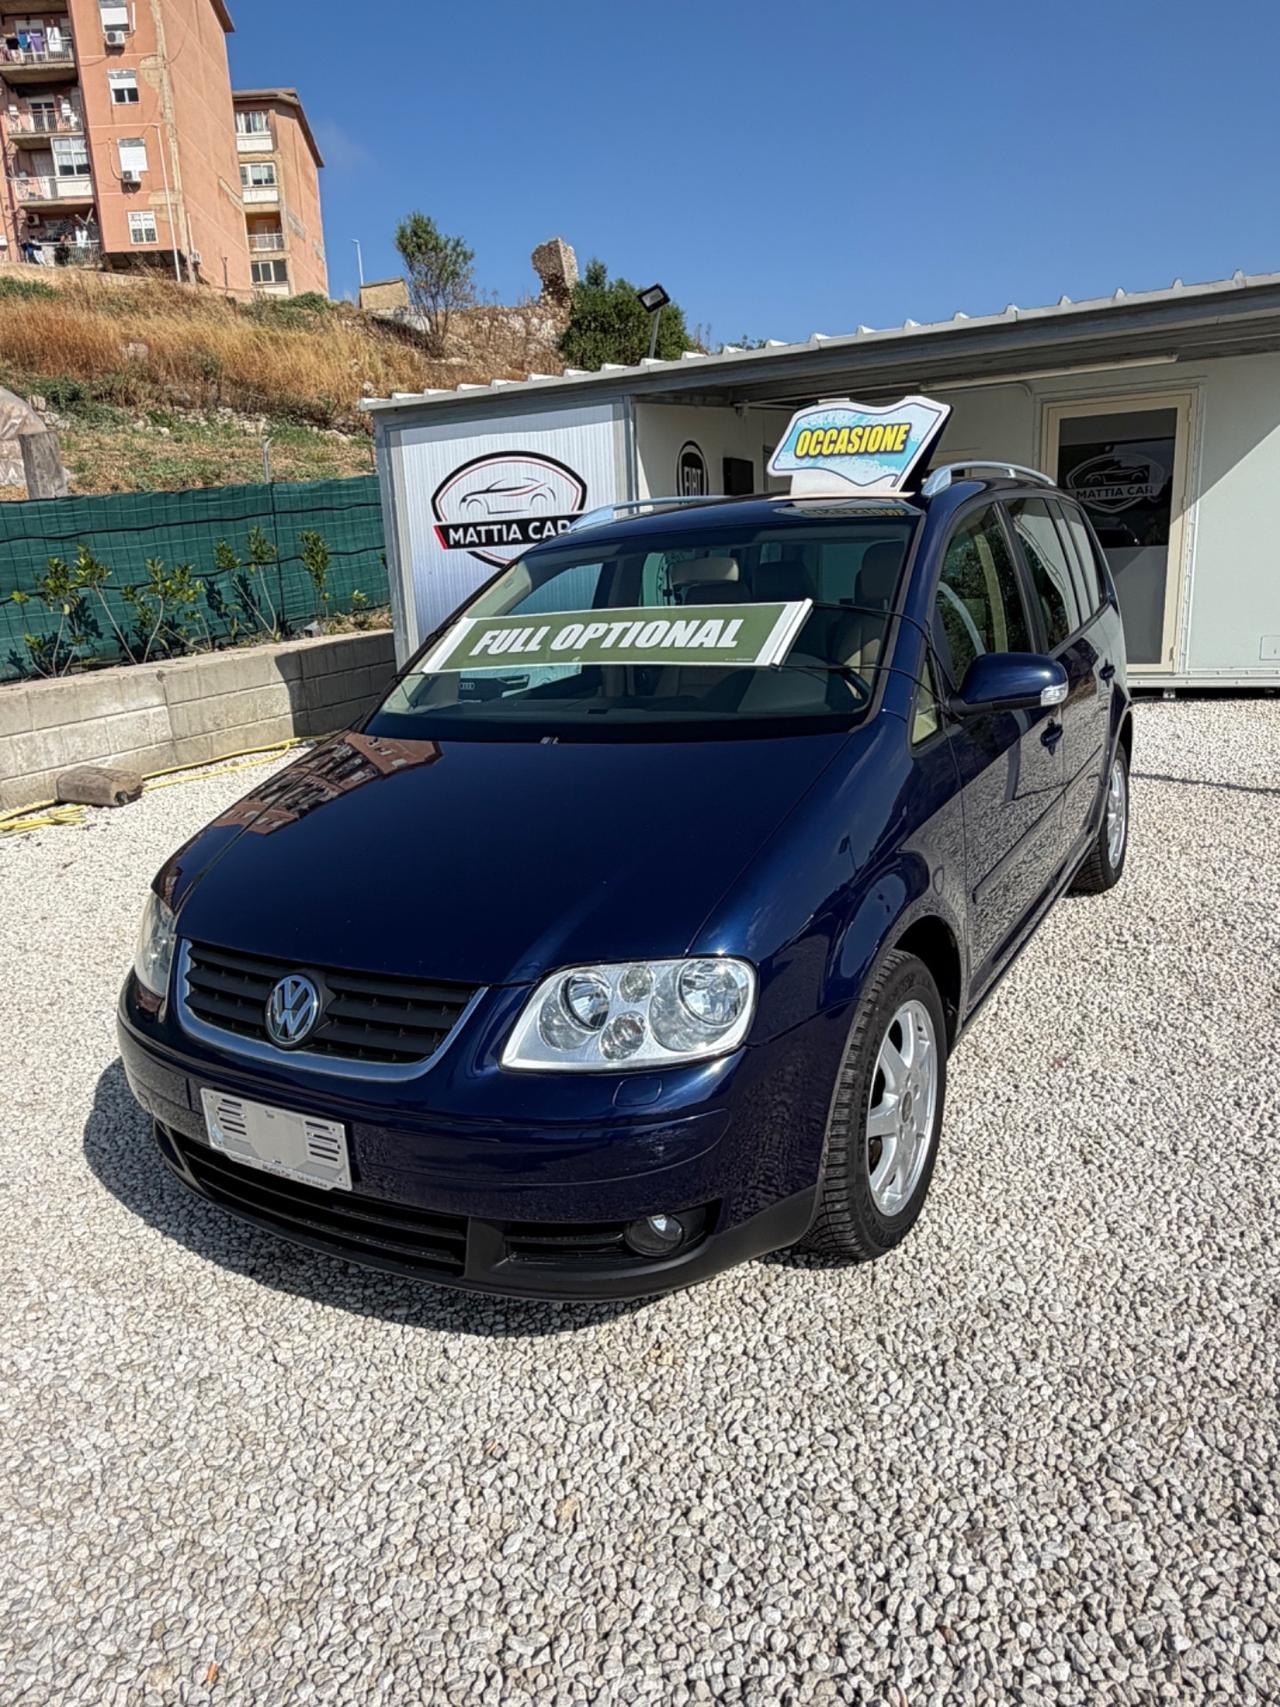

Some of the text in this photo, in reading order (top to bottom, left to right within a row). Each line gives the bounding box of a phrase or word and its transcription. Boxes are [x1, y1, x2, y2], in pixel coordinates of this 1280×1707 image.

[795, 423, 911, 458] OCCASIONE
[683, 466, 702, 496] FIAT
[1076, 484, 1153, 499] MATTIA CAR
[449, 521, 522, 545] MATTIA
[468, 618, 744, 656] FULL OPTIONAL
